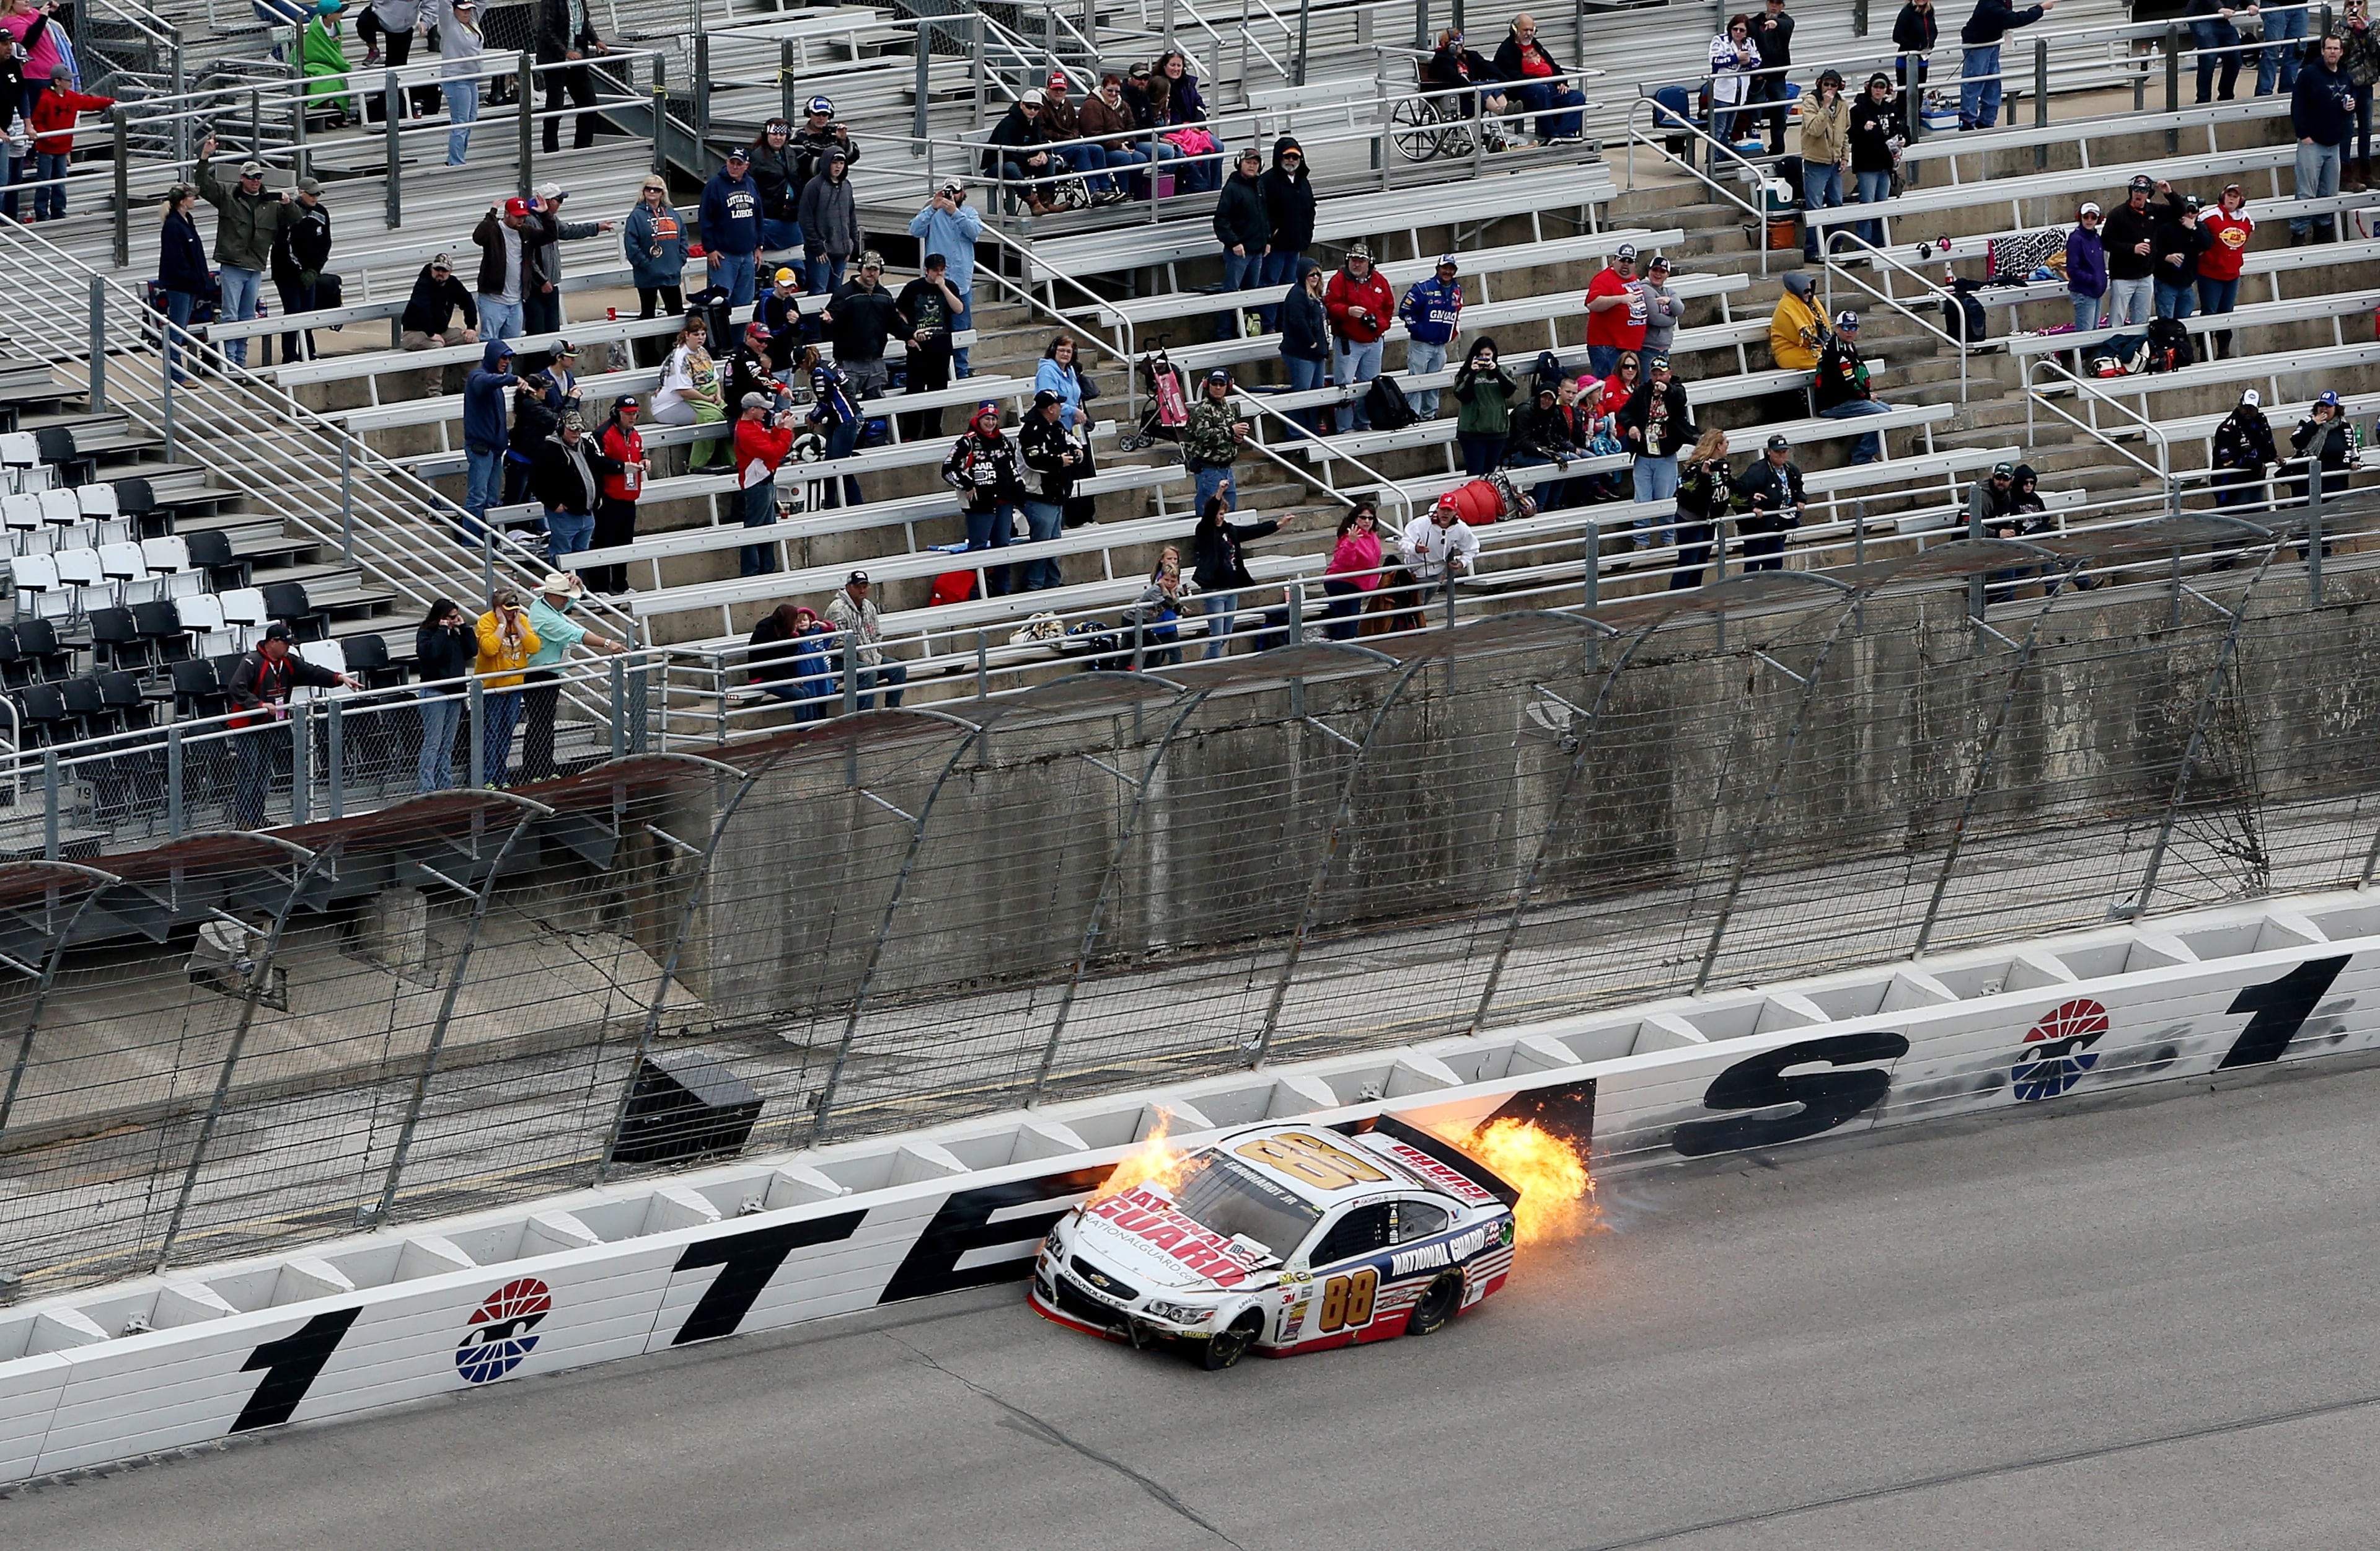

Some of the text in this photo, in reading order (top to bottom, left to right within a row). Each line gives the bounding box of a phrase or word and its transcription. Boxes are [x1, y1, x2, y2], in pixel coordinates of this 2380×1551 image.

[517, 200, 525, 209] T
[731, 208, 753, 218] LOBOS
[972, 462, 995, 471] AAR
[76, 787, 92, 800] 19
[2217, 954, 2353, 1071] 1
[1223, 1161, 1298, 1206] EARNHARDT JR
[1233, 1132, 1393, 1191] 88
[1086, 1195, 1246, 1288] GUARD
[1120, 1185, 1235, 1253] NATIONAL
[1391, 1227, 1485, 1277] NATIONAL GUARD
[1064, 1270, 1113, 1303] CHEVROLET
[1281, 1293, 1296, 1305] 3M
[1320, 1269, 1377, 1333] 88
[228, 1306, 364, 1434] 1
